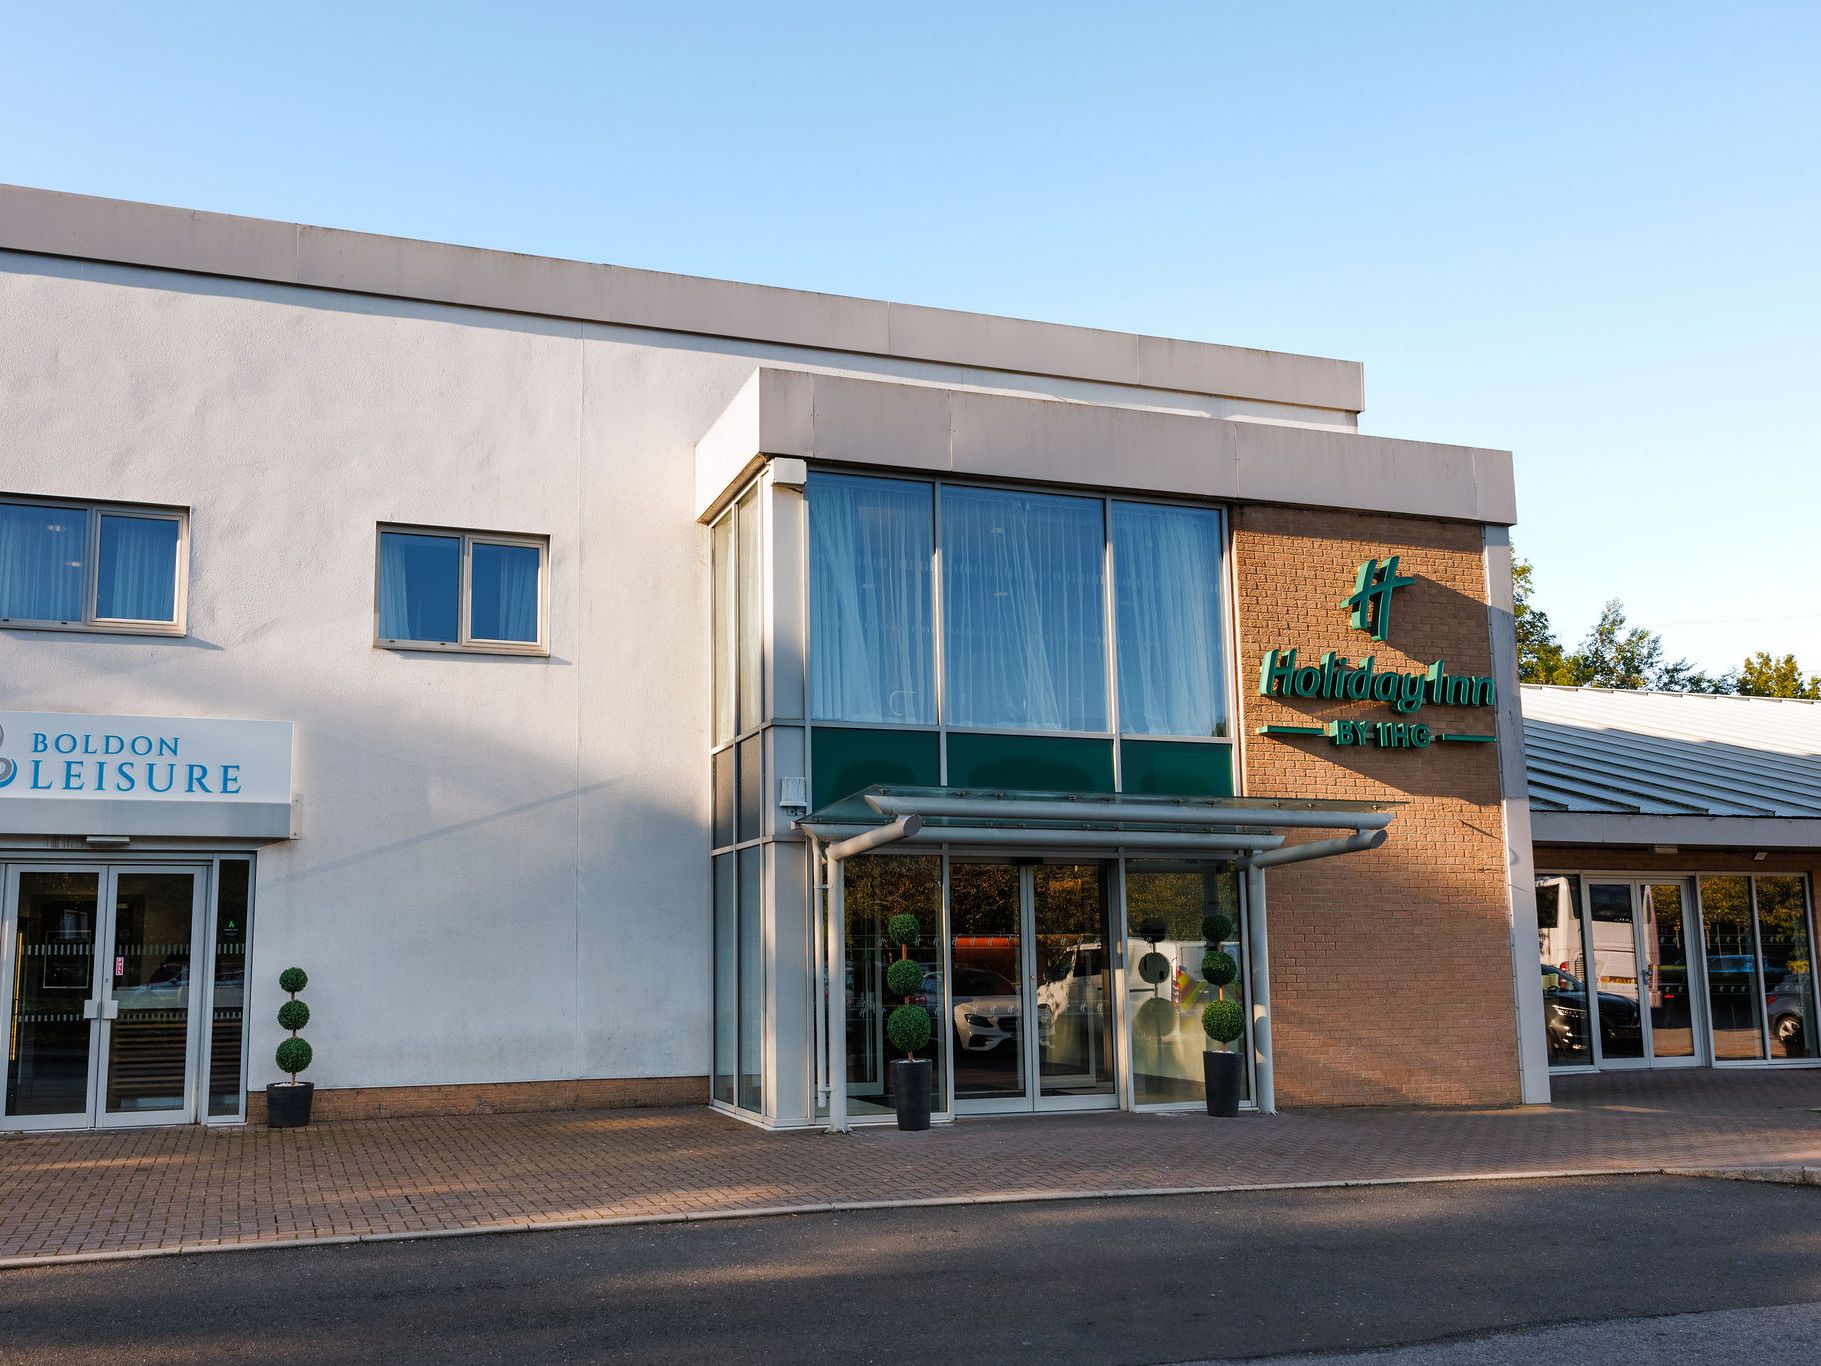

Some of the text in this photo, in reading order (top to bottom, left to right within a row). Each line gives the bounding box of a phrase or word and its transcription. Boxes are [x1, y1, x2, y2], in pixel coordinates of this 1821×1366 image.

[1259, 649, 1496, 713] Holiday Inn
[32, 732, 180, 757] BOLDON
[1330, 720, 1432, 748] BY IHG
[30, 759, 242, 794] LEISURE
